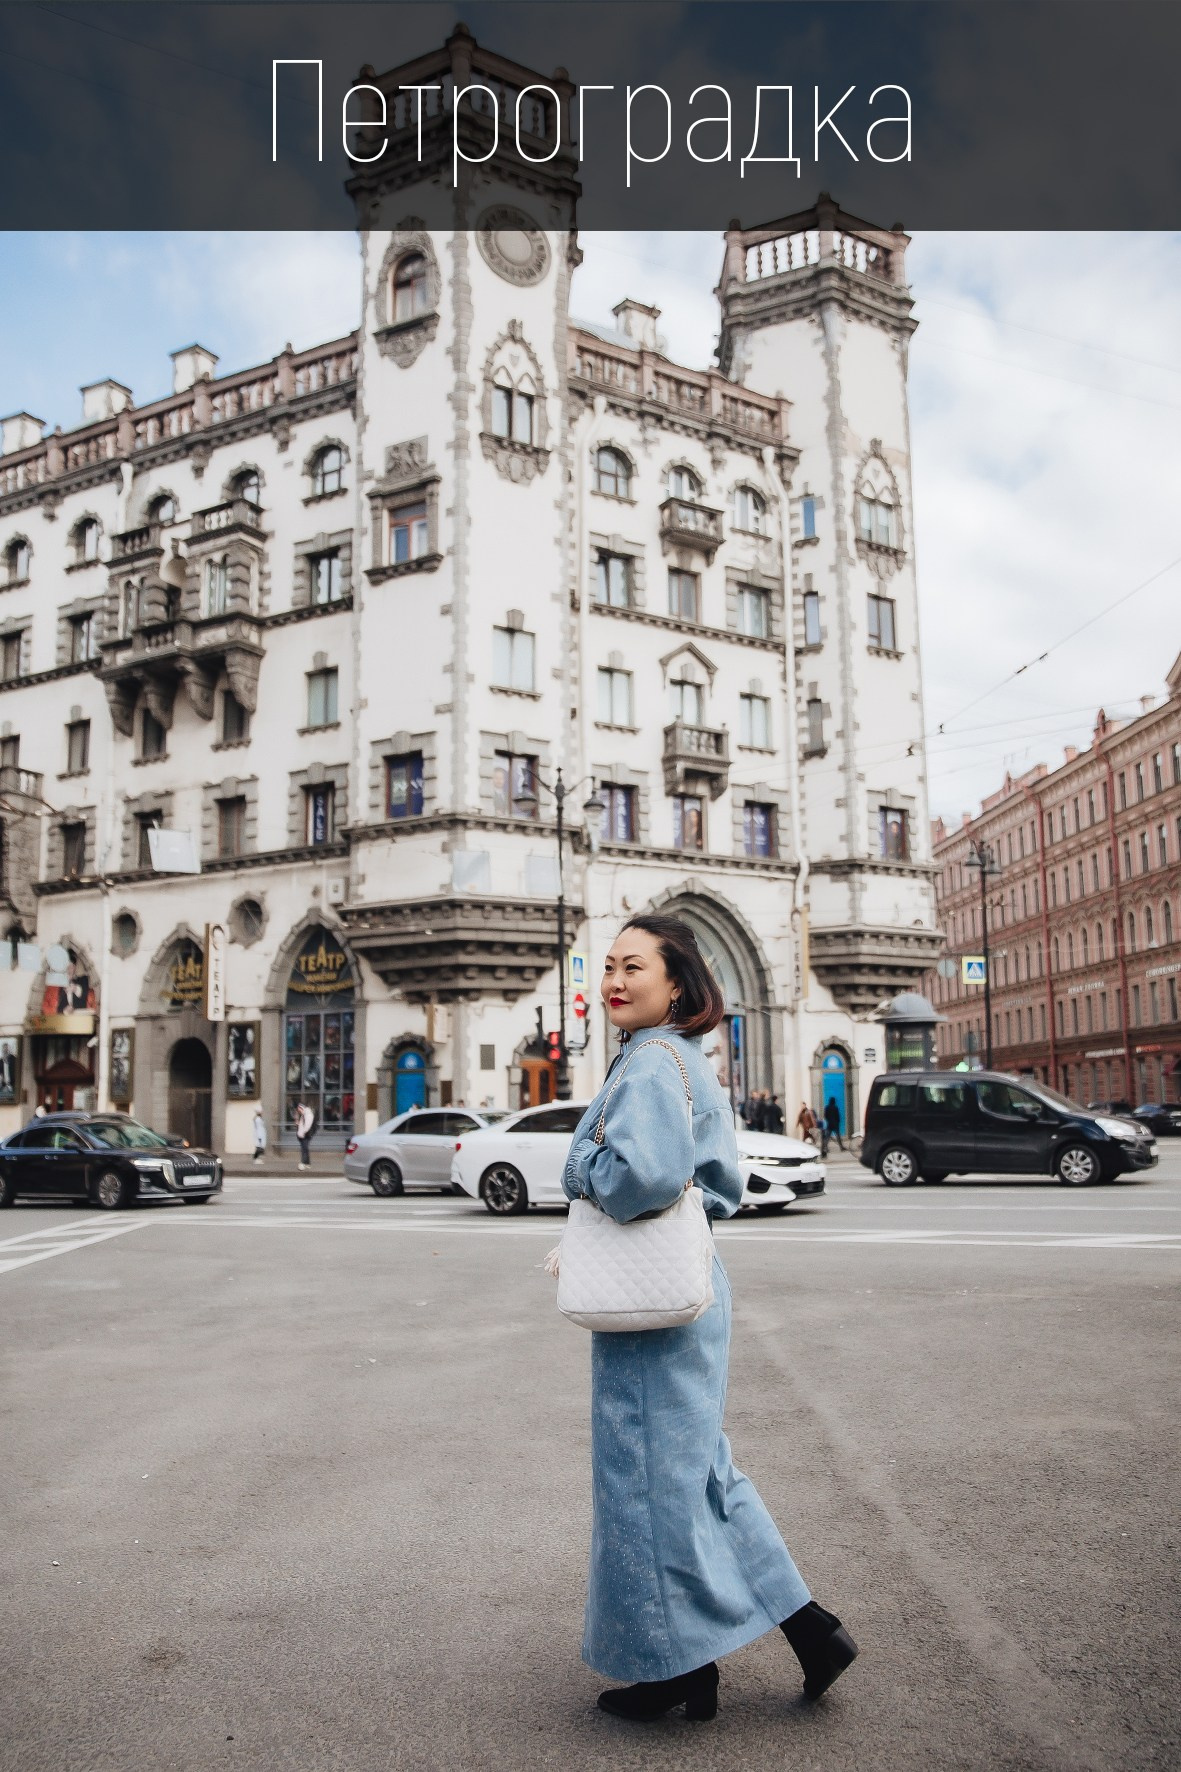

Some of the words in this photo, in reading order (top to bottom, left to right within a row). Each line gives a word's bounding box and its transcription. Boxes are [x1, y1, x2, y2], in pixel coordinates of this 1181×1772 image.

[316, 795, 324, 840] SALE
[171, 957, 202, 981] ТЕАТ
[299, 944, 345, 971] ТЕАТР
